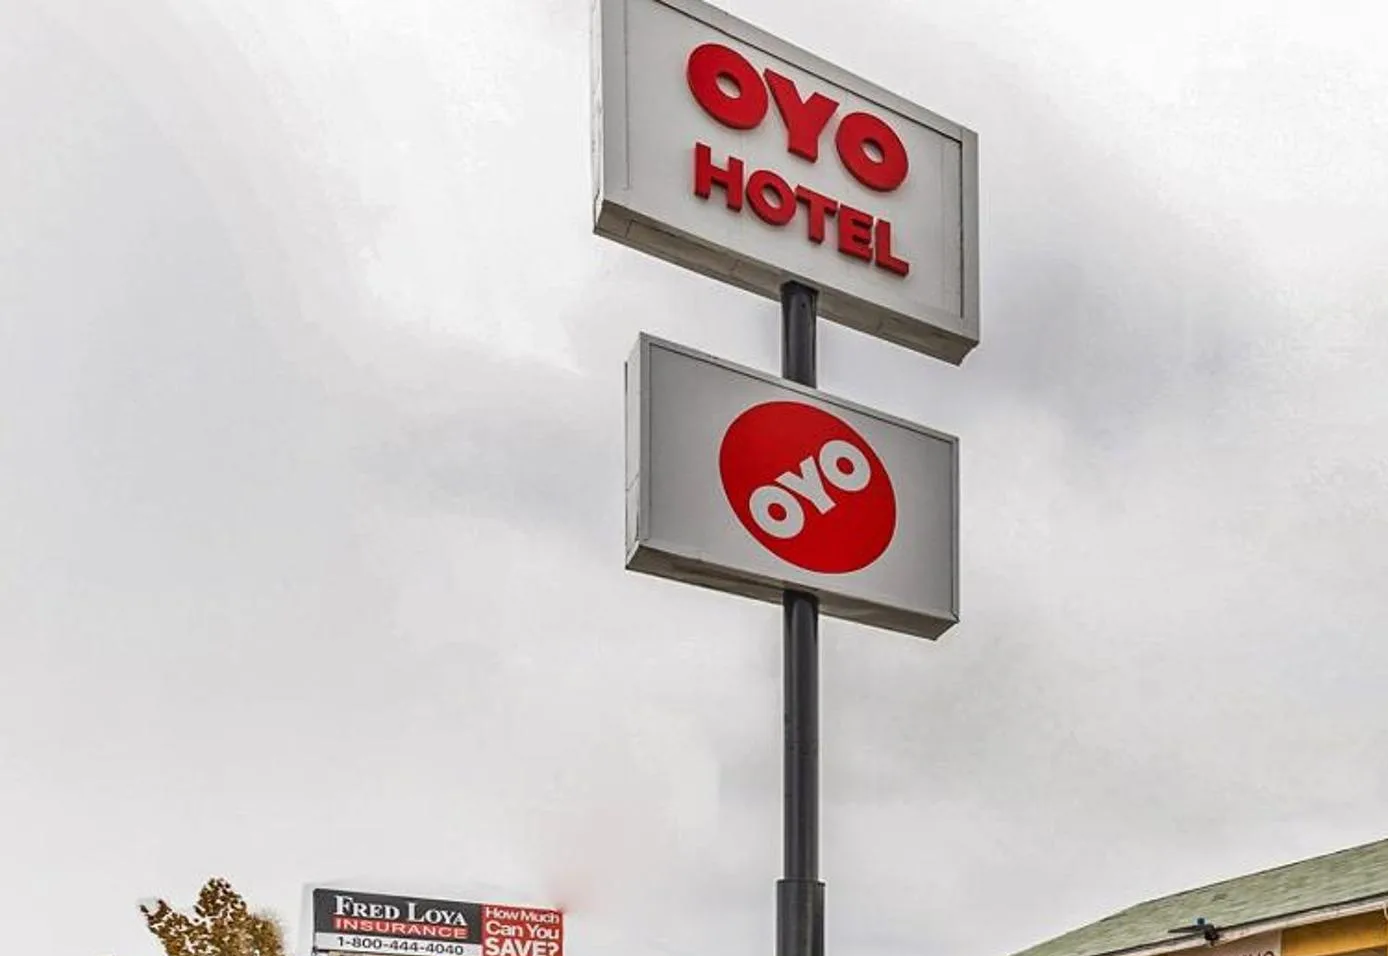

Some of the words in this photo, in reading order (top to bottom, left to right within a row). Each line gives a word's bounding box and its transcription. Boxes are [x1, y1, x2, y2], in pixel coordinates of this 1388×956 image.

[687, 43, 909, 192] OYO
[694, 142, 909, 277] HOTEL
[749, 440, 872, 539] OYO
[485, 907, 519, 922] How
[520, 909, 560, 924] Much
[335, 917, 469, 939] INSURANCE
[485, 921, 523, 937] Can
[526, 923, 560, 940] You
[338, 936, 464, 955] 1-800-444-4040
